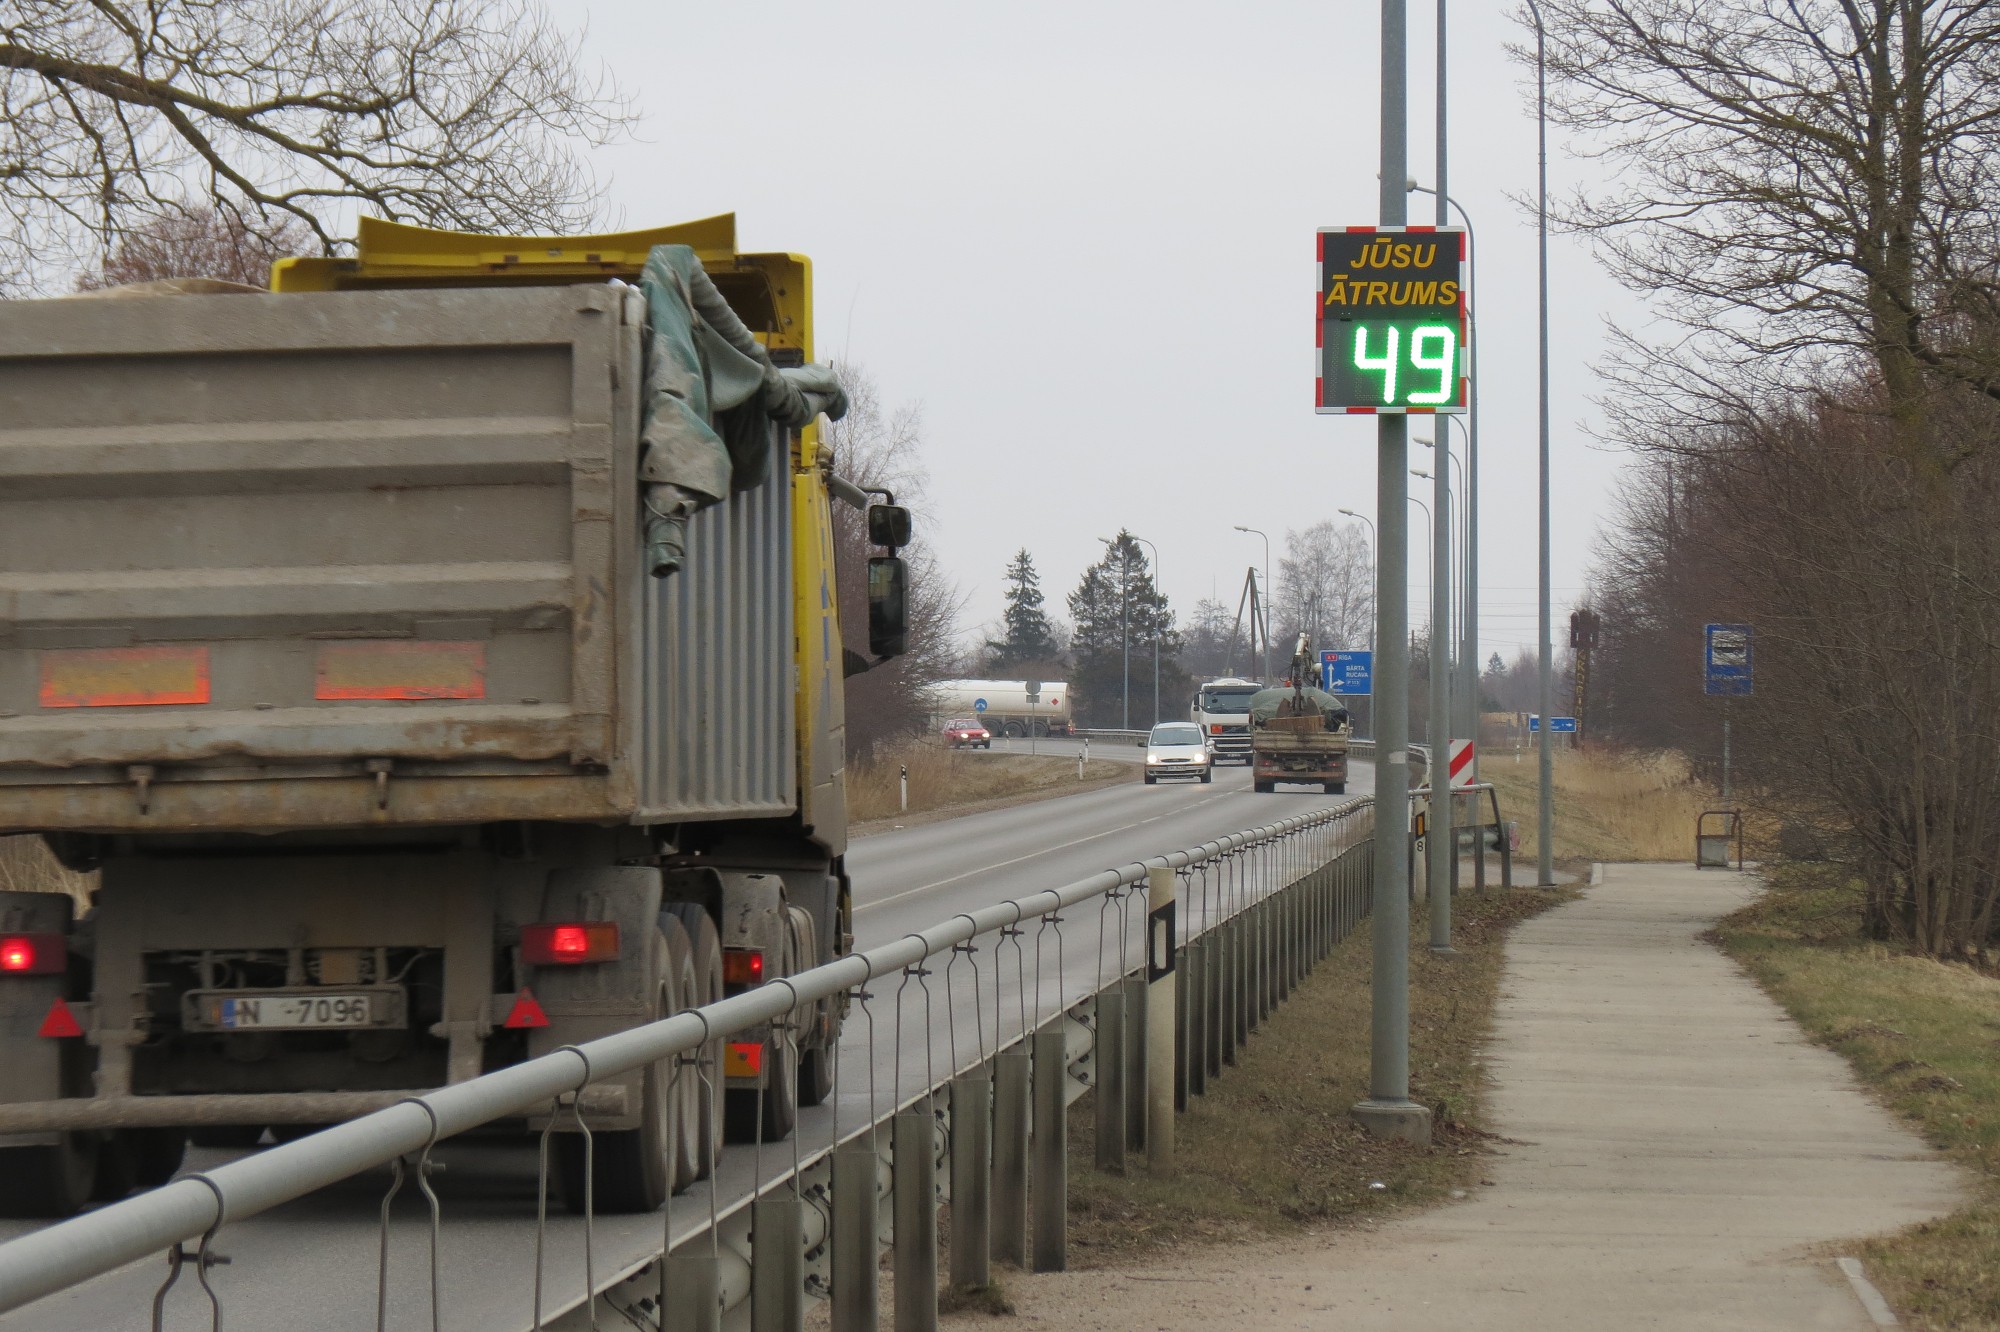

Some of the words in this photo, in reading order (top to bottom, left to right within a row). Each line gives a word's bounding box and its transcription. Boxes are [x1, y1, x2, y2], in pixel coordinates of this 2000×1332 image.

[1350, 237, 1437, 269] JŪSU
[1325, 274, 1458, 305] ĀTRUMS
[1354, 326, 1456, 404] 49
[1416, 840, 1424, 852] 8
